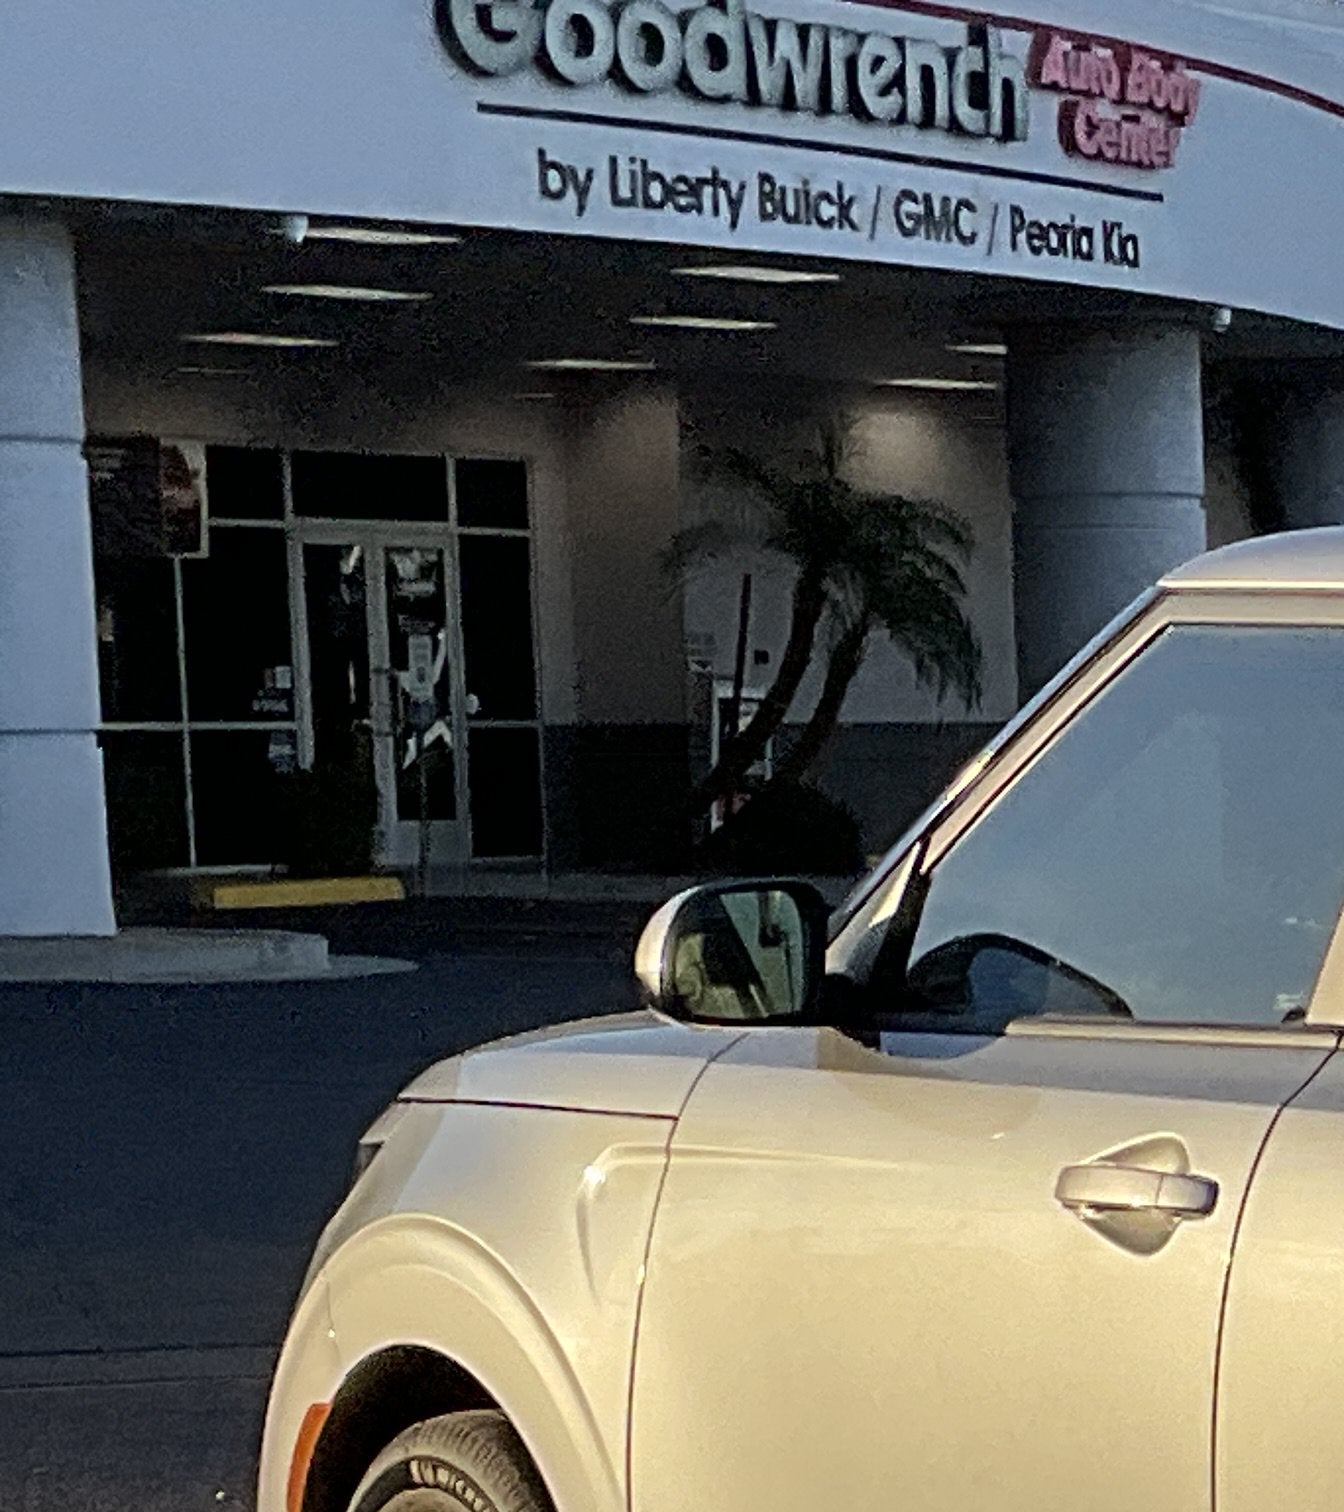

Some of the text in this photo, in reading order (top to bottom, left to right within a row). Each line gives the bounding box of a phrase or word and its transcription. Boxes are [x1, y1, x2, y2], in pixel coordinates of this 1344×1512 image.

[440, 0, 1029, 142] Goodwrench
[537, 146, 594, 218] by
[608, 154, 747, 233] Liberty
[757, 170, 861, 232] Buick
[894, 188, 978, 246] GMC
[1009, 203, 1095, 262] Peoria
